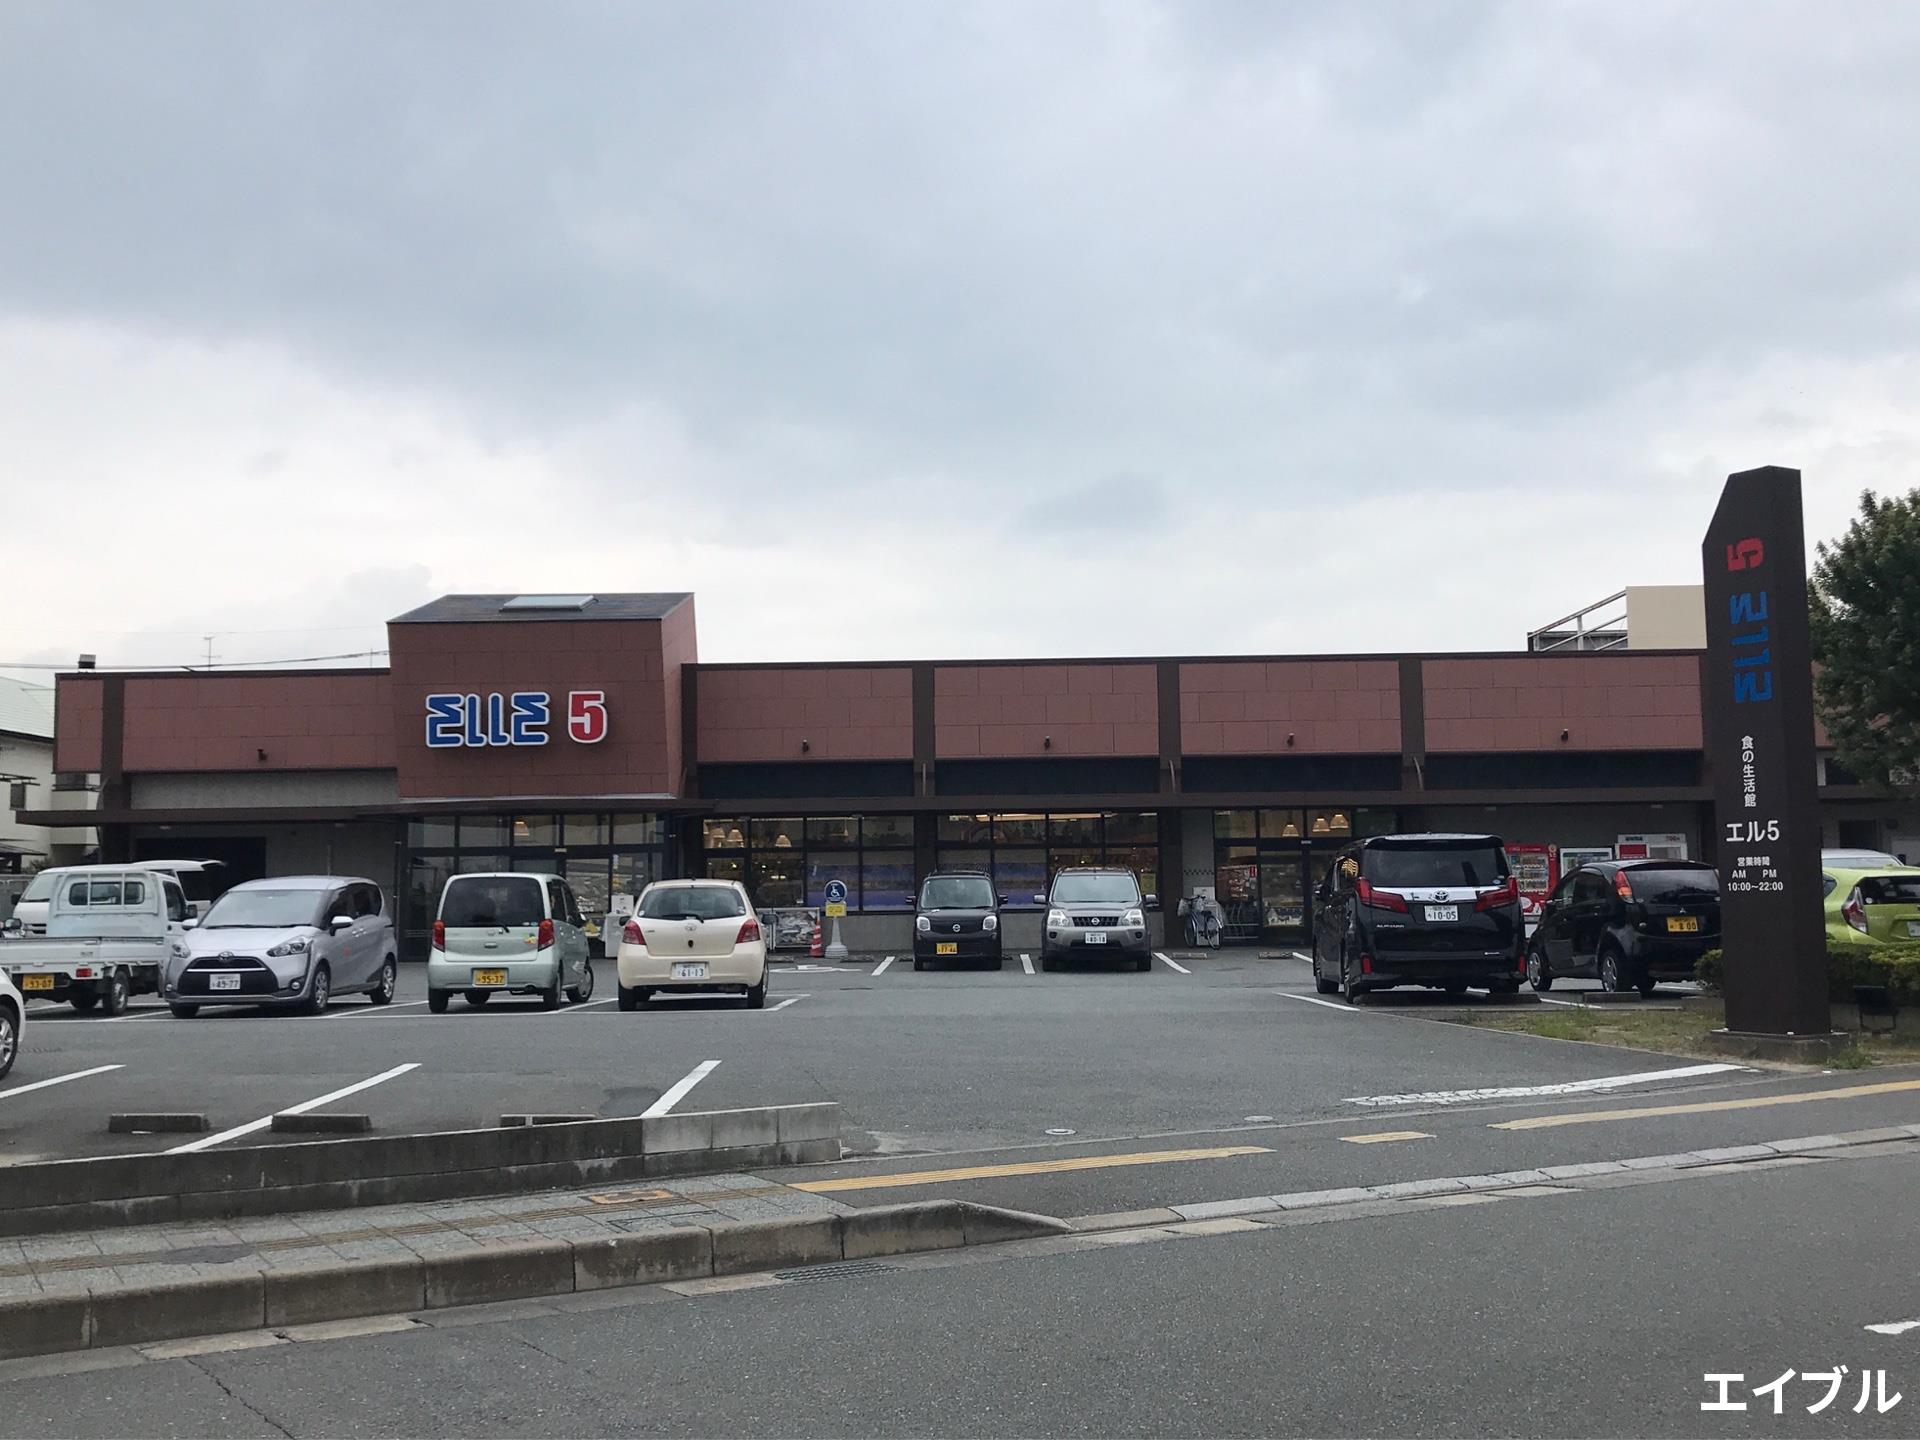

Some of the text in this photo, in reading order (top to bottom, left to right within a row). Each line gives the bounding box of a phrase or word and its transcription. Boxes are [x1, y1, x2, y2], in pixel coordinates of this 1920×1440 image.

[1727, 537, 1773, 703] ELLE 5
[426, 690, 608, 748] ELLE 5
[1741, 735, 1757, 807] 食の生活館
[1726, 820, 1780, 842] エル5
[1732, 869, 1777, 879] AM PM
[1737, 856, 1770, 867] 営業時間
